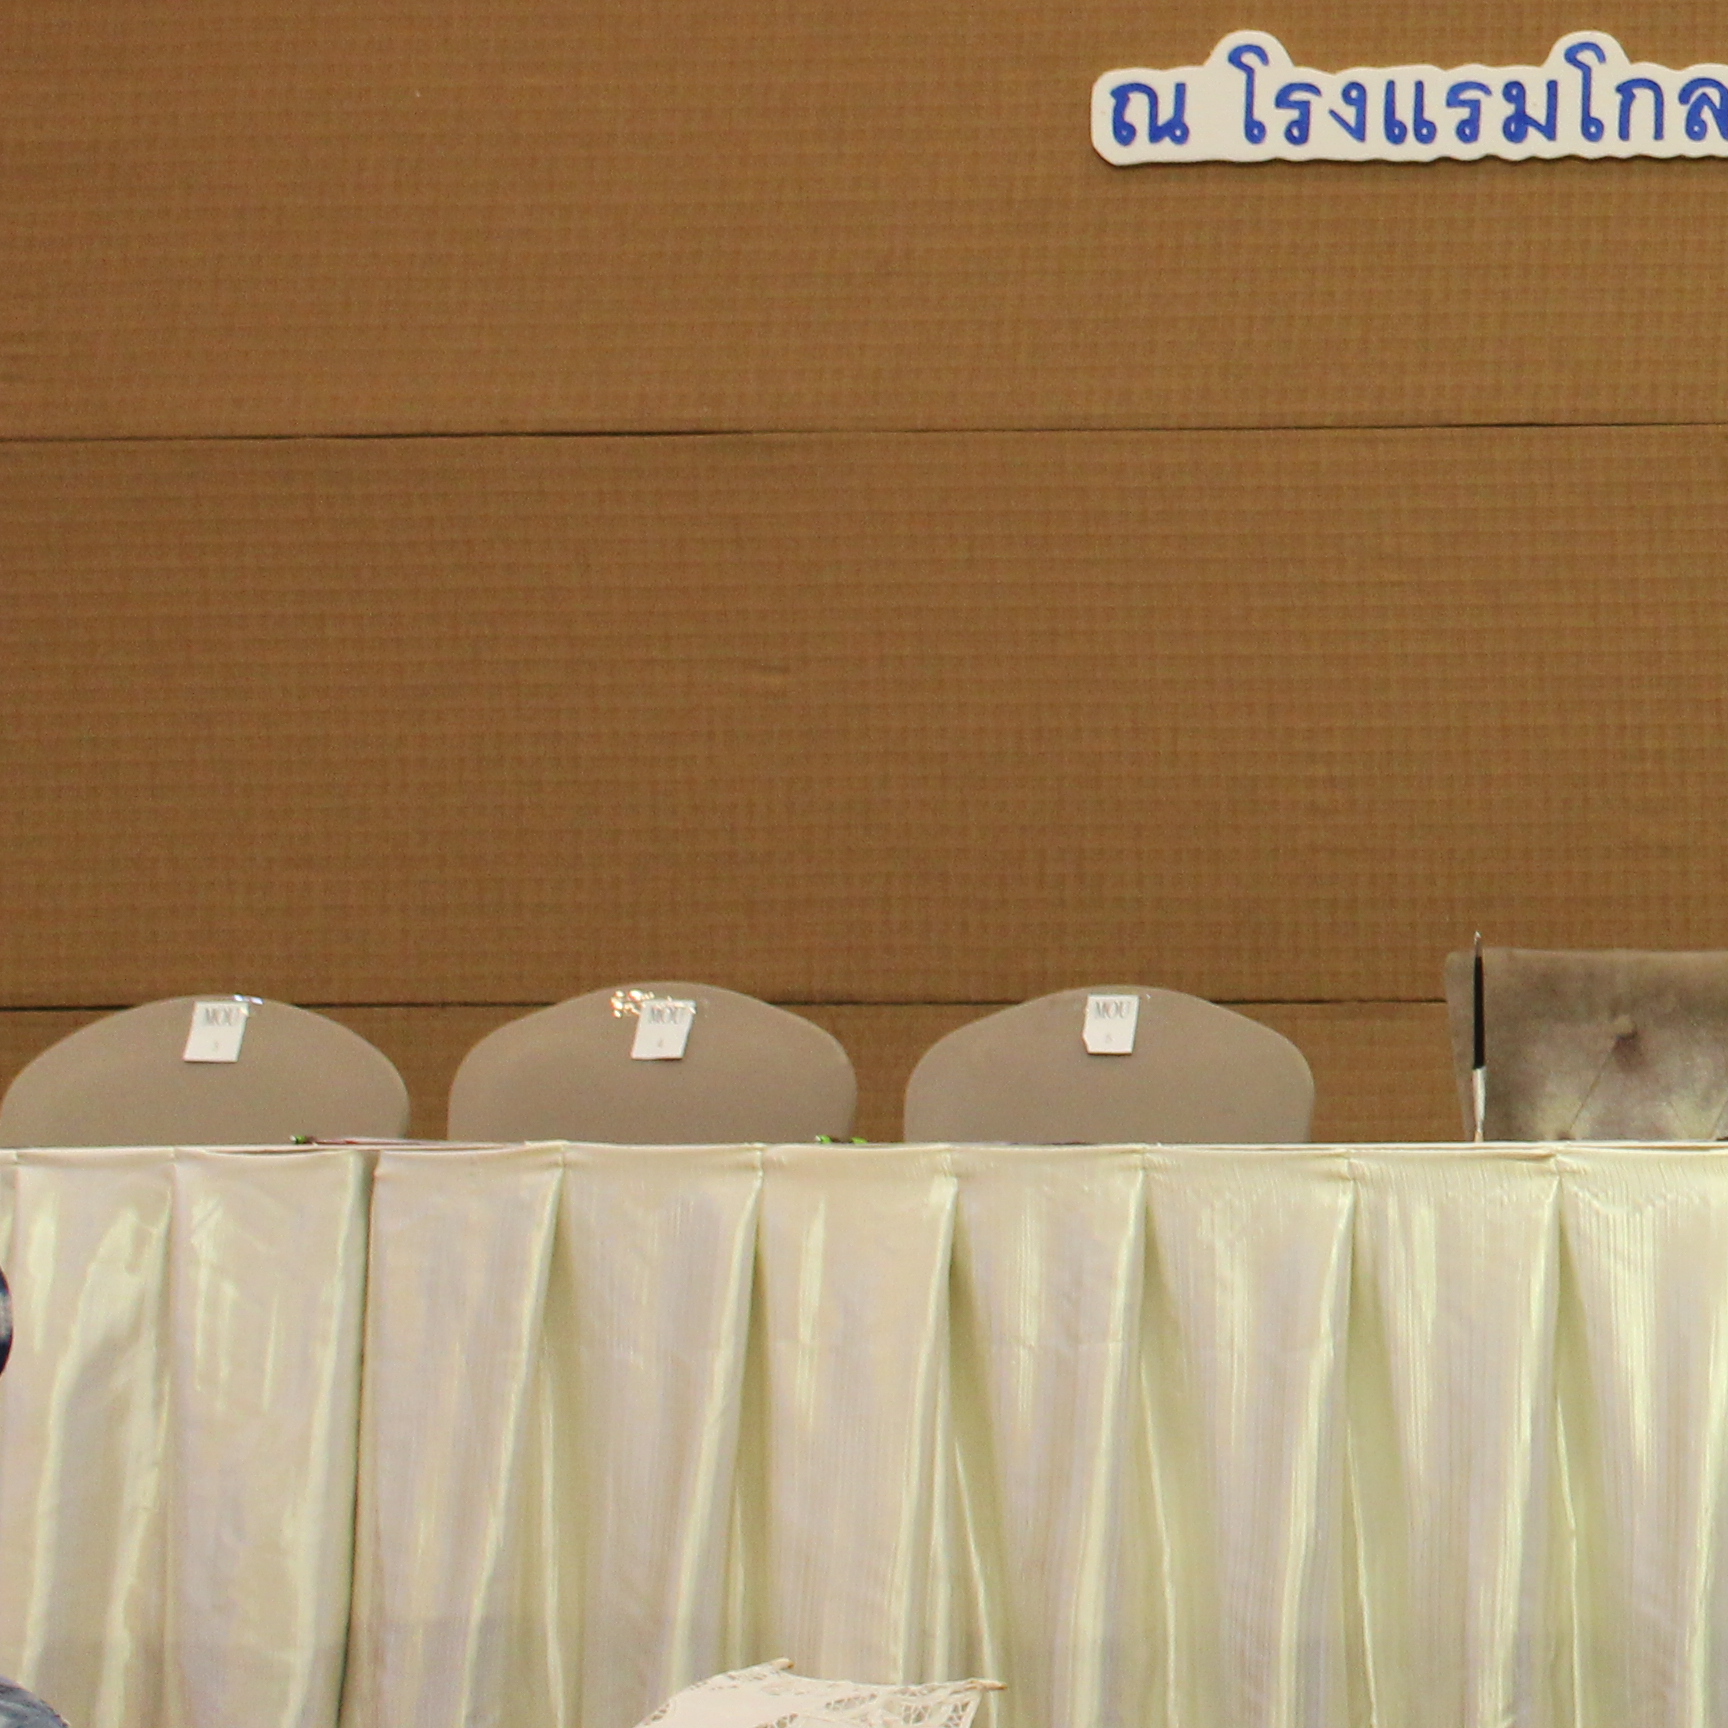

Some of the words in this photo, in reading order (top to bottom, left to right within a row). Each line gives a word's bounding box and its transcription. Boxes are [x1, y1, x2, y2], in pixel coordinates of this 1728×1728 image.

[1110, 82, 1189, 146] ณ
[204, 1007, 242, 1026] MOU
[648, 1005, 685, 1024] MOU
[1094, 1001, 1131, 1019] MOU
